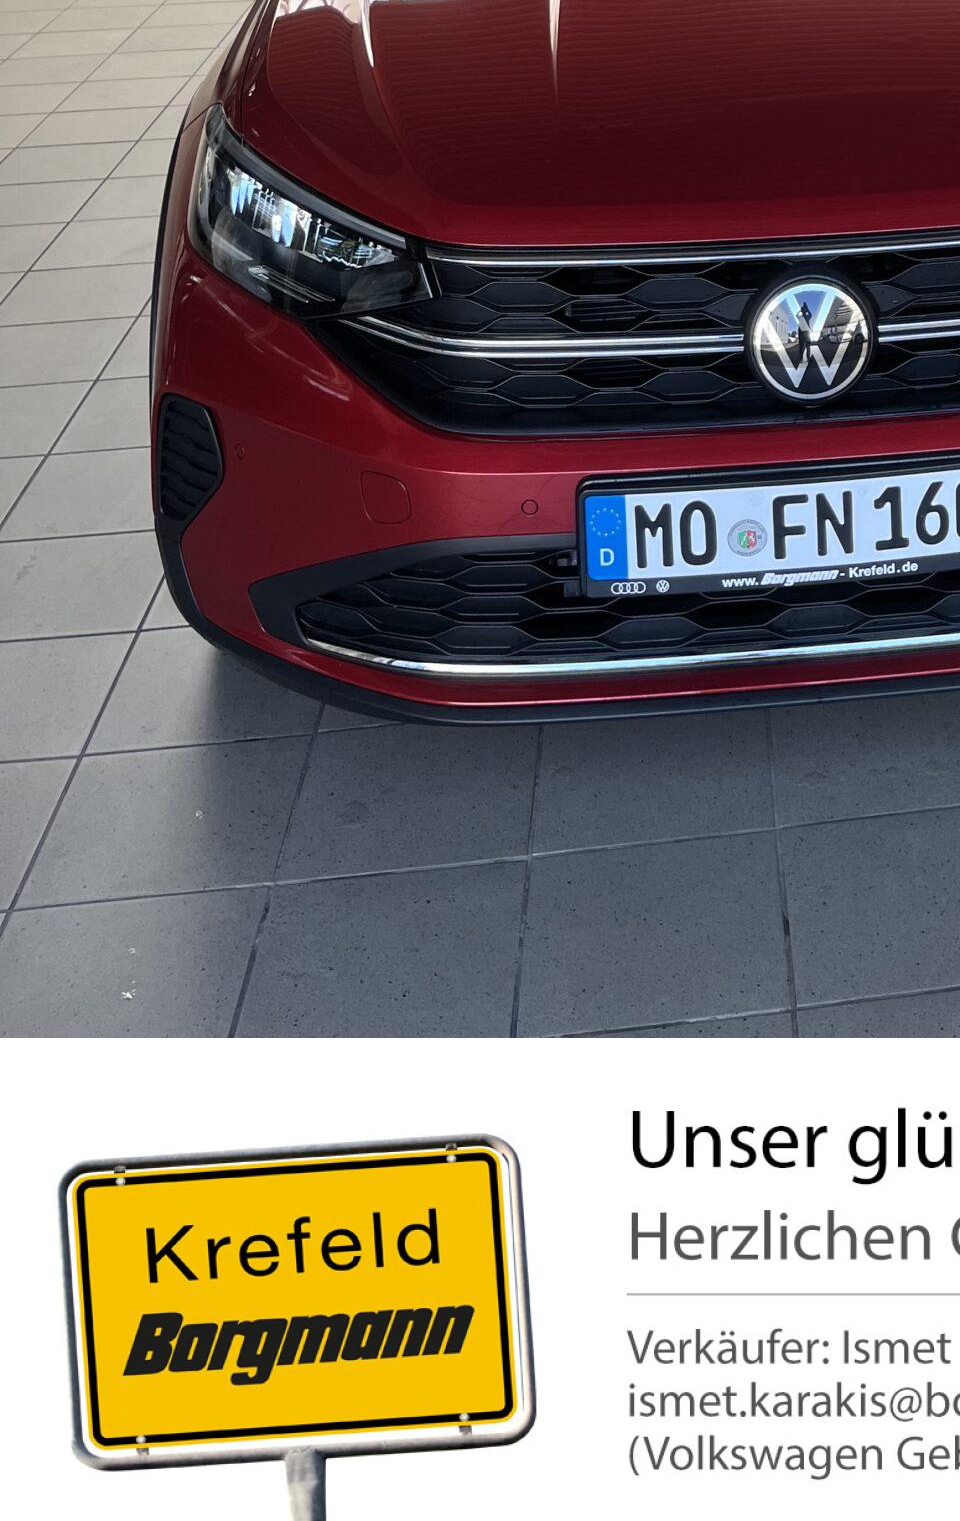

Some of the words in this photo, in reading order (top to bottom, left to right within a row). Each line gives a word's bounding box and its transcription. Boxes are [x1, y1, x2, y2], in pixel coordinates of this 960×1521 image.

[599, 548, 615, 567] D
[634, 500, 717, 569] MO
[772, 491, 854, 560] FN
